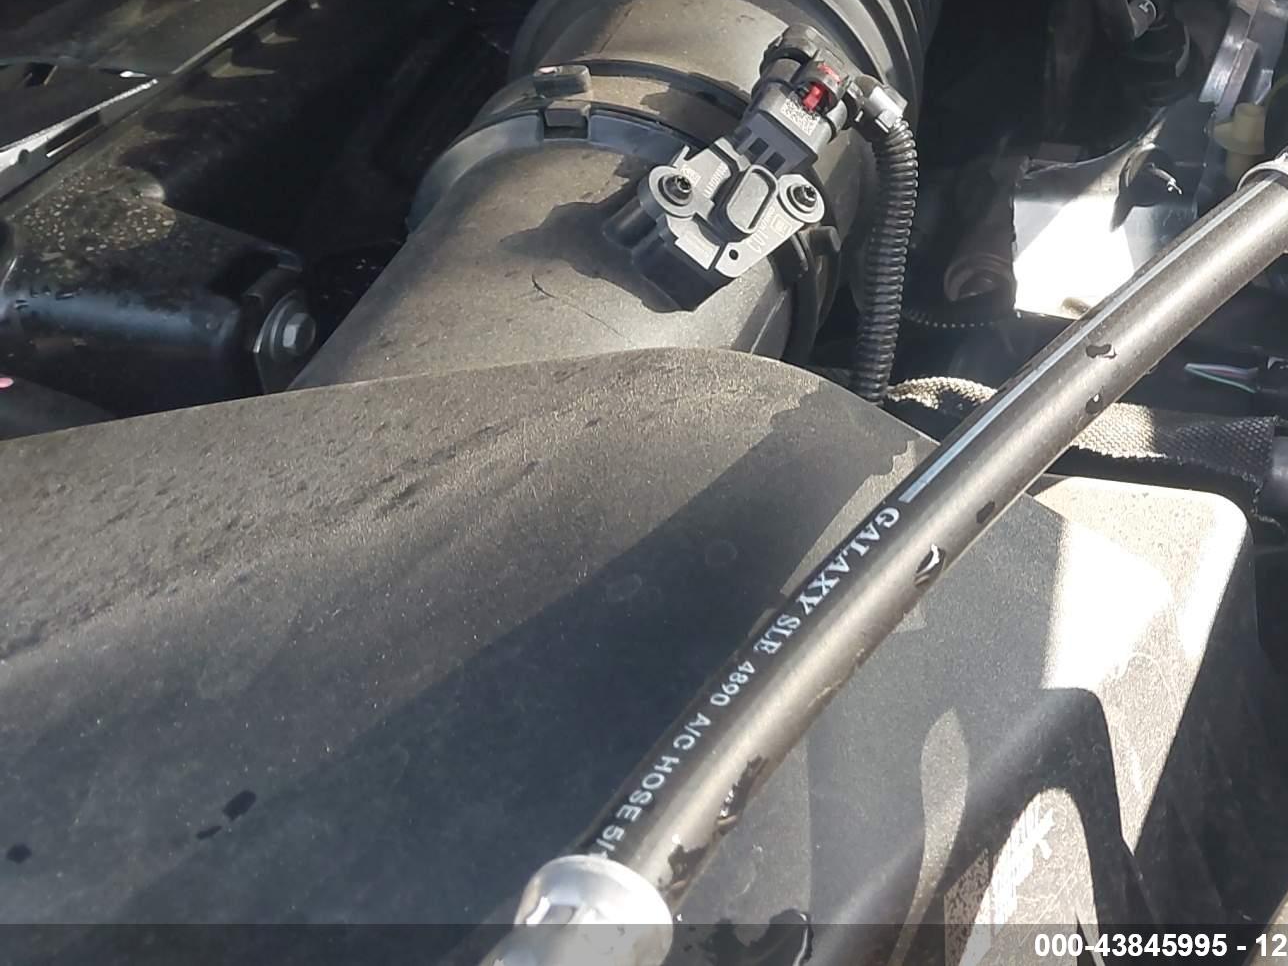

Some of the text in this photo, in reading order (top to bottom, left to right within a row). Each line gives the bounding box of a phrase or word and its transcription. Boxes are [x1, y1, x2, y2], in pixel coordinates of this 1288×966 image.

[795, 506, 901, 616] GALAXY
[709, 660, 757, 707] 4890
[672, 712, 712, 751] A/C
[615, 755, 680, 823] HOSE
